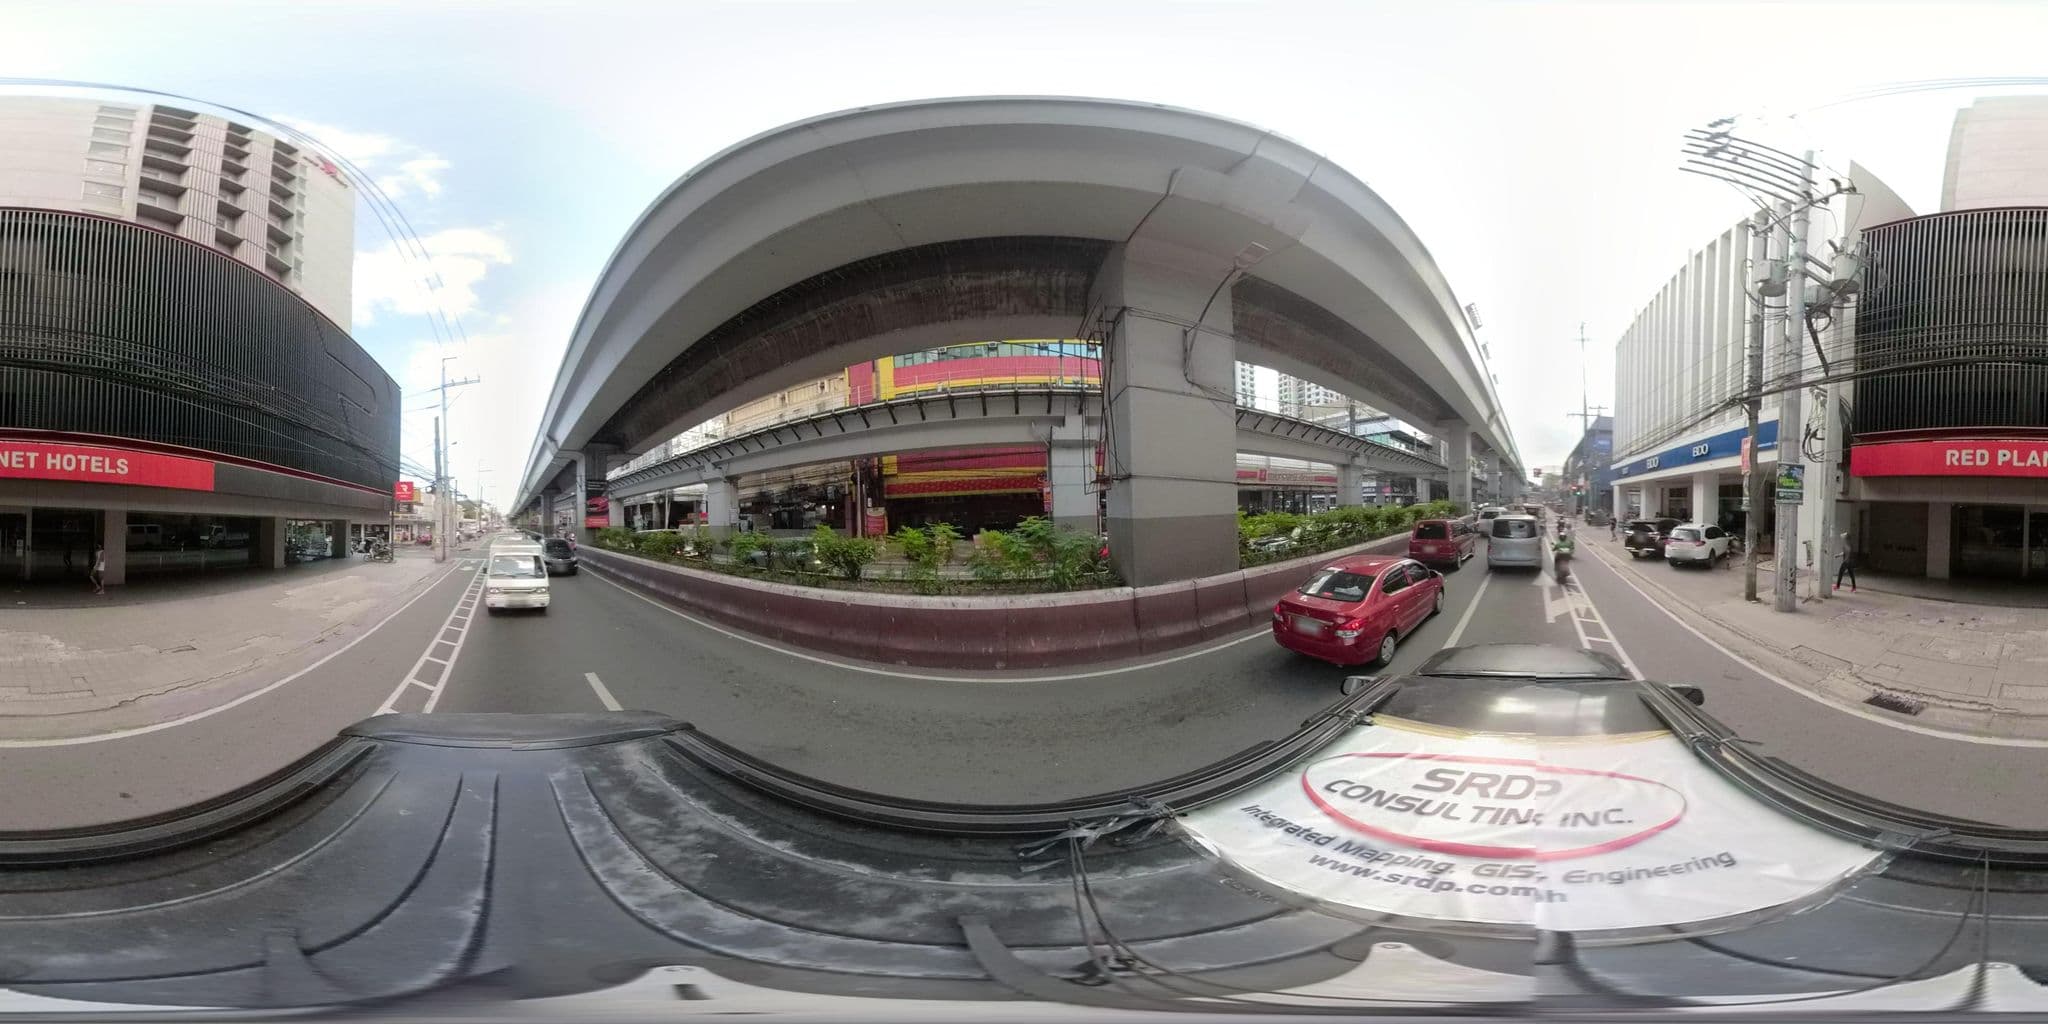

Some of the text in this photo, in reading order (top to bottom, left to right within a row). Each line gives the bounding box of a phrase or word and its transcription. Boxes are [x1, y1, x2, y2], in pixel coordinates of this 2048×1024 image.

[1692, 443, 1709, 457] BDO
[1945, 449, 1990, 466] RED
[46, 453, 129, 475] HOTELS
[1241, 804, 1337, 847] Integrated
[1562, 851, 1737, 885] Engineering
